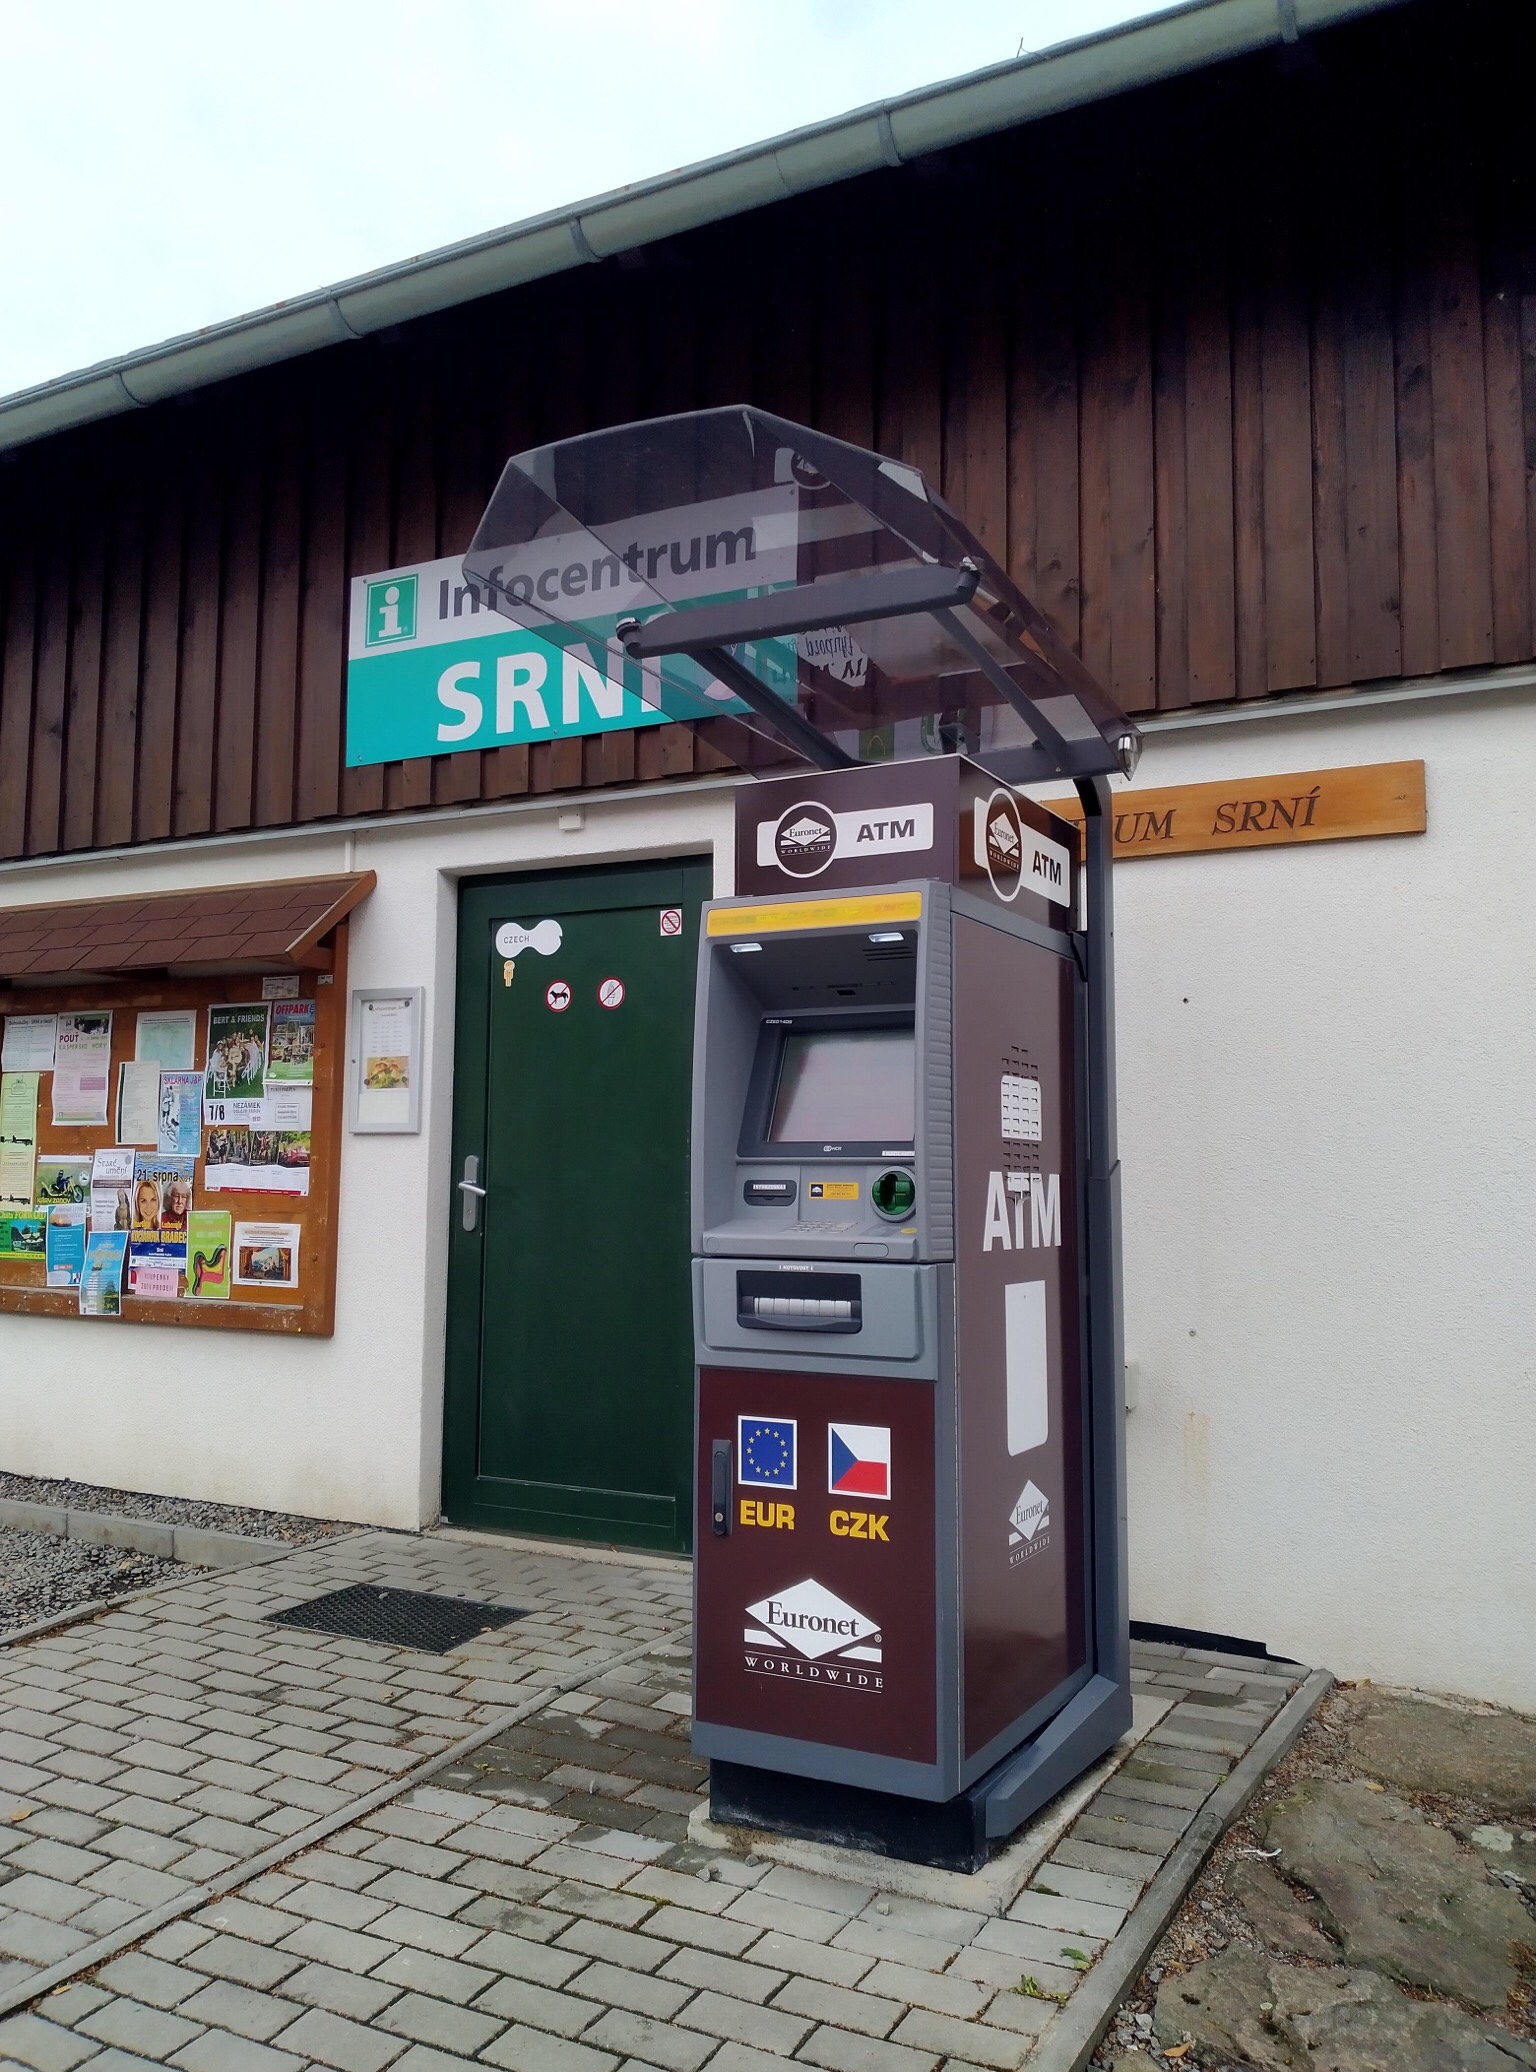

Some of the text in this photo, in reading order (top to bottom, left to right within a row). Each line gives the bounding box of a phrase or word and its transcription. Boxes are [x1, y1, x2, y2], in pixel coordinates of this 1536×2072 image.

[438, 526, 757, 620] Infocentrum
[1113, 785, 1321, 843] UM SRNÍ
[788, 826, 823, 839] Euronet
[856, 818, 915, 843] ATM
[994, 821, 1015, 844] Euronet
[780, 844, 831, 855] WORLDWIDE
[1032, 850, 1062, 886] ATM
[503, 935, 530, 944] CZECH
[213, 1014, 265, 1024] BERT & FRIENDS
[276, 1003, 310, 1015] OFFPARK
[208, 1104, 225, 1121] 7/8
[136, 1169, 150, 1182] 21.
[153, 1171, 179, 1184] srpna
[983, 1171, 1062, 1251] ATM
[740, 1499, 796, 1531] EUR
[1015, 1500, 1044, 1525] Euronet
[829, 1510, 890, 1542] CZK
[1008, 1536, 1051, 1564] WORLDWIDE
[766, 1600, 860, 1638] Euronet
[744, 1656, 883, 1689] WORLDWIDE
